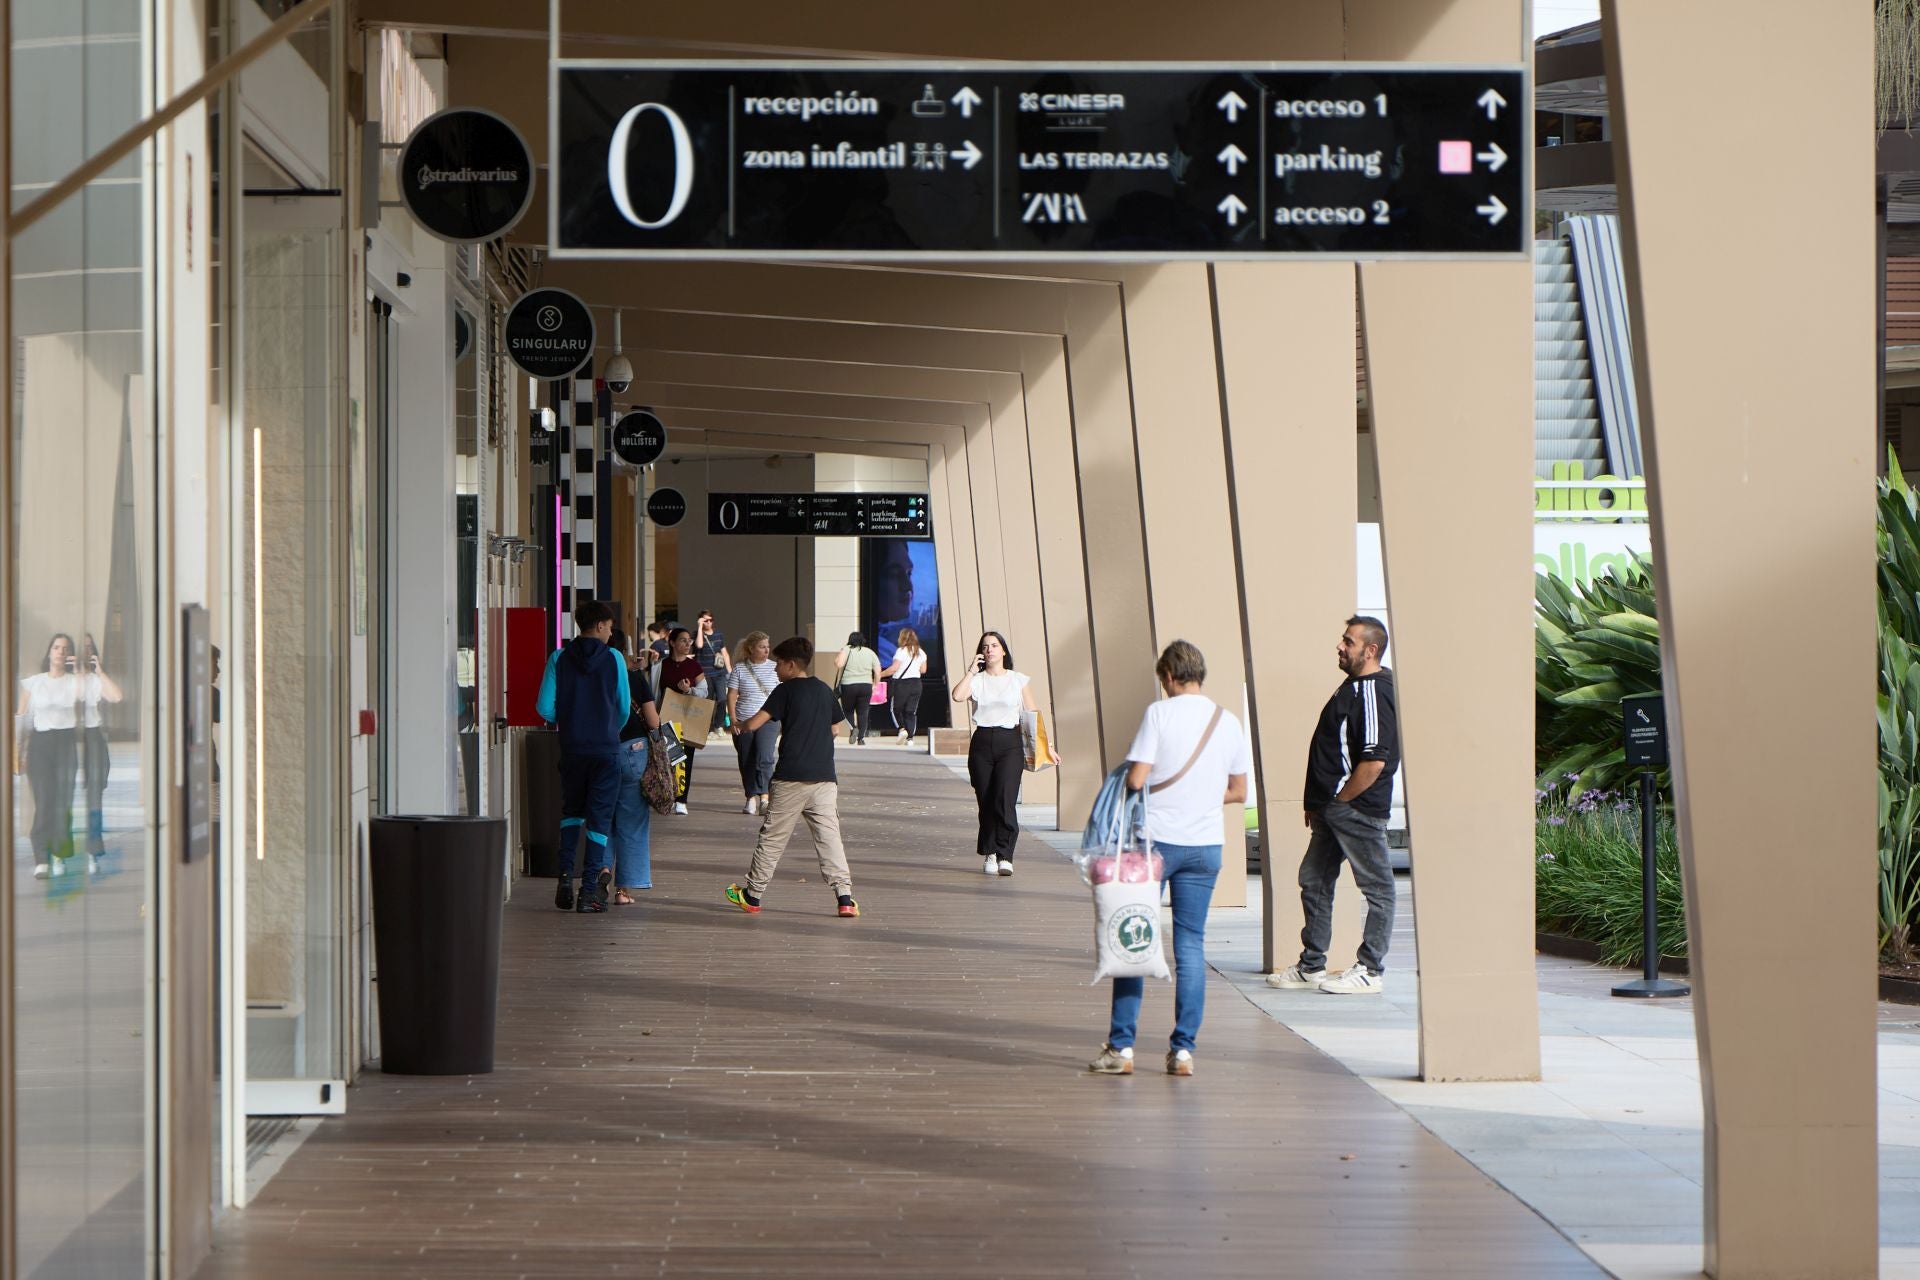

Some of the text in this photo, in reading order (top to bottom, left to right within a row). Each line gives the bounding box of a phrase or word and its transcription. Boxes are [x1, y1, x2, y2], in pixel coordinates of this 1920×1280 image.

[744, 90, 879, 121] recepción
[1040, 93, 1125, 110] CINESA
[1274, 93, 1388, 117] acceso 1
[607, 102, 694, 230] 0
[743, 141, 906, 168] zona infantil
[1019, 152, 1169, 170] LAS TERRAZAS
[1274, 144, 1383, 178] parking
[1022, 192, 1088, 223] ZARA
[1274, 199, 1390, 225] acceso 2
[512, 338, 587, 350] SINGULARU
[620, 437, 657, 446] HOLLISTER
[871, 498, 897, 507] parking
[871, 508, 897, 517] parking
[719, 500, 740, 530] 0
[871, 523, 899, 531] acceso 1
